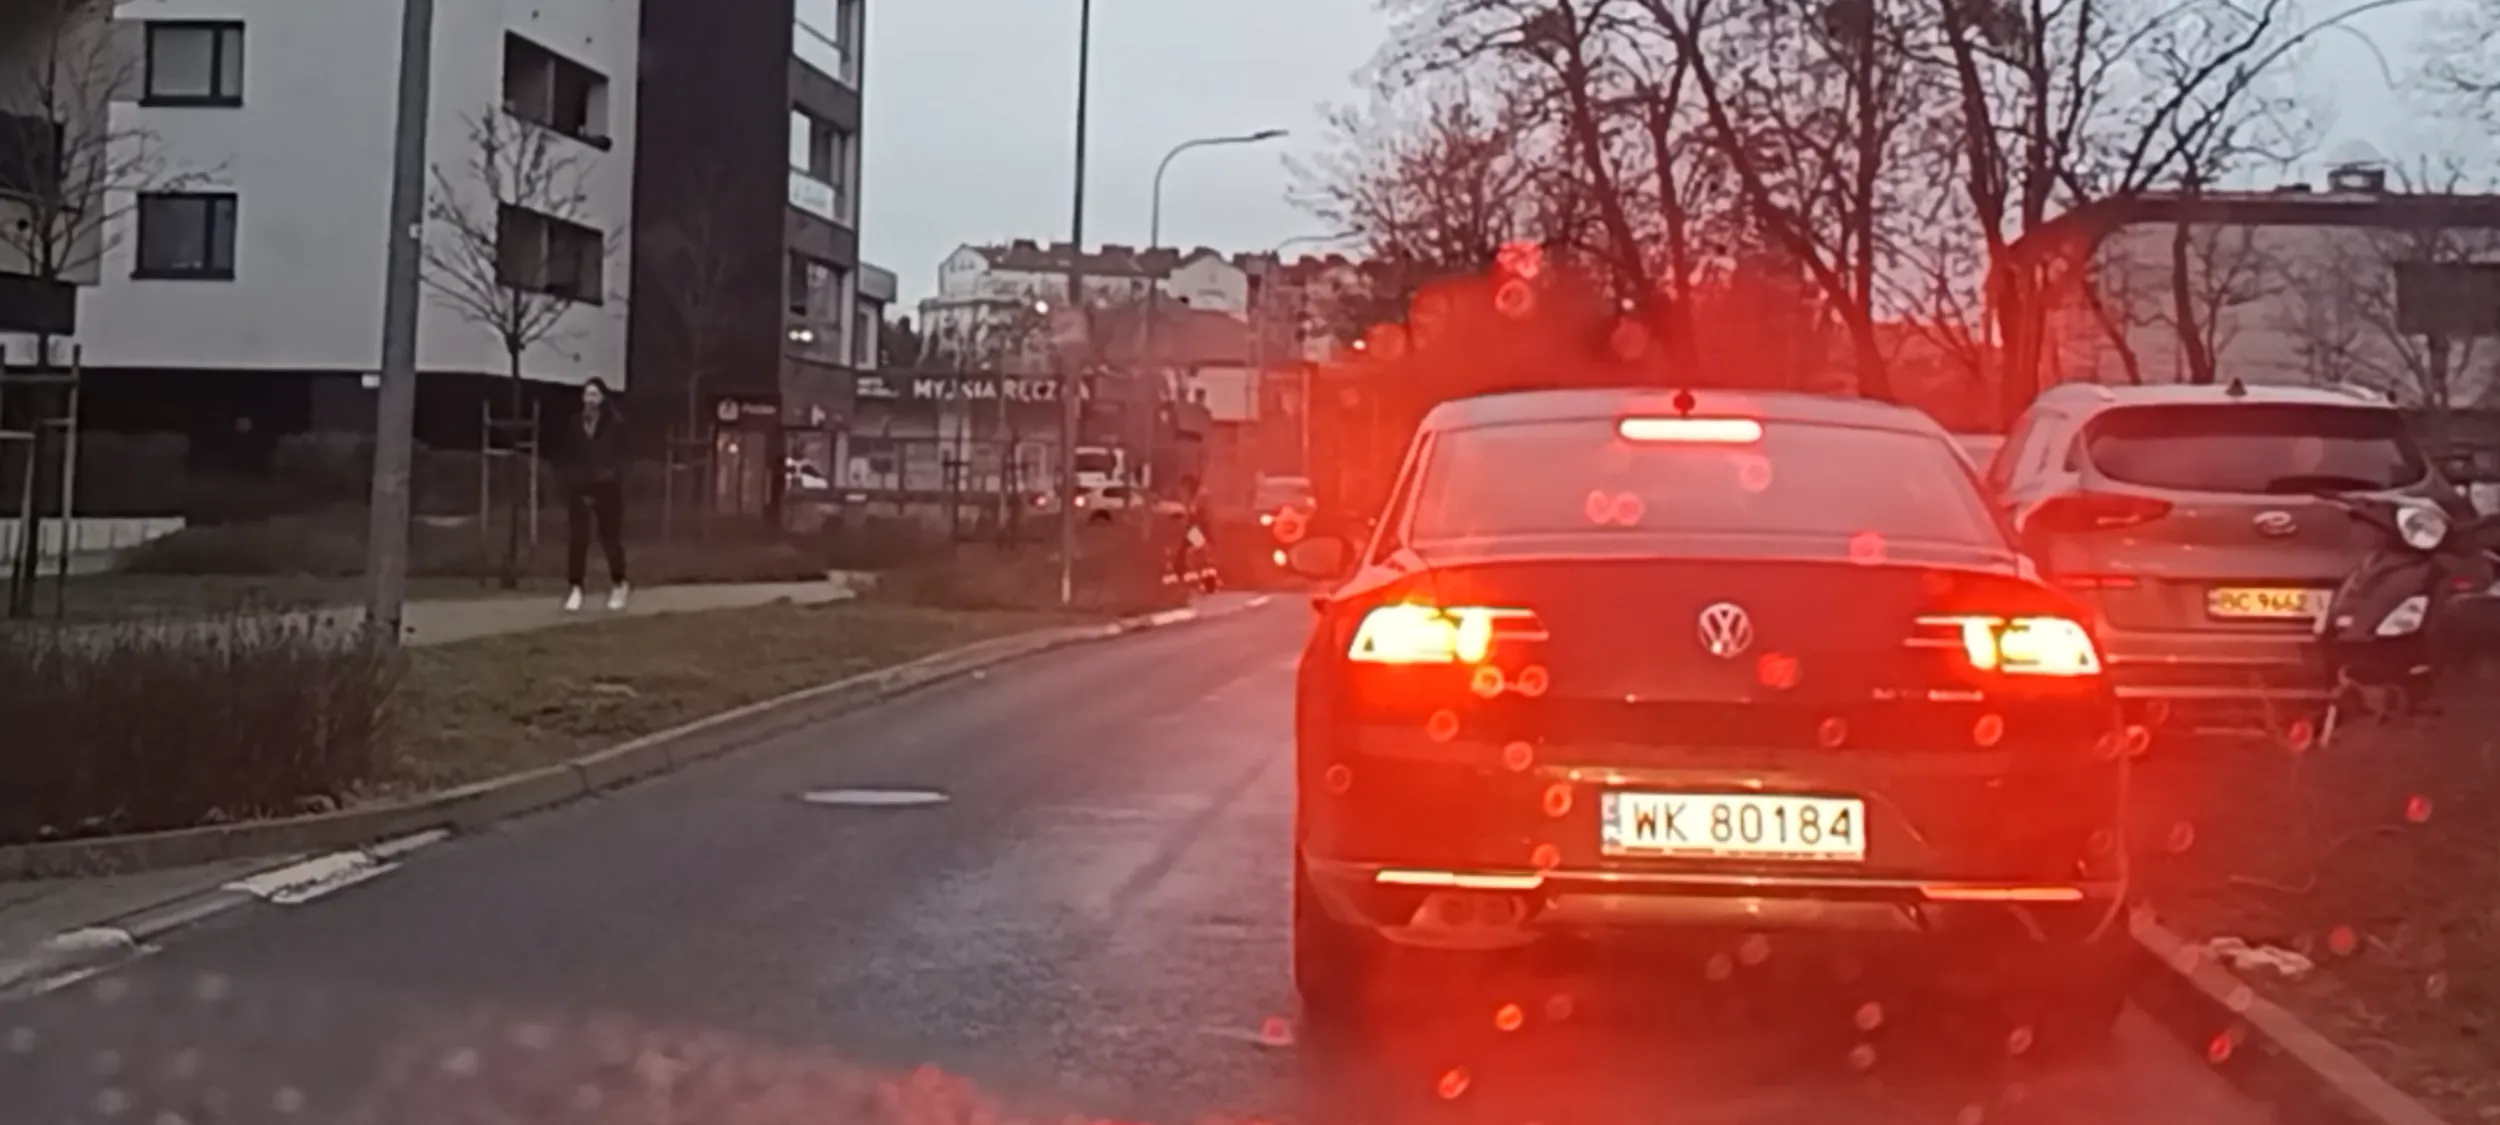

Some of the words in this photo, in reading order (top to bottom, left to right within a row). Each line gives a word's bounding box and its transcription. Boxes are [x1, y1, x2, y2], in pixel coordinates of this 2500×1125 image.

[1003, 379, 1090, 403] RĘCZA
[1633, 801, 1688, 842] WK
[1711, 803, 1852, 846] 80184
